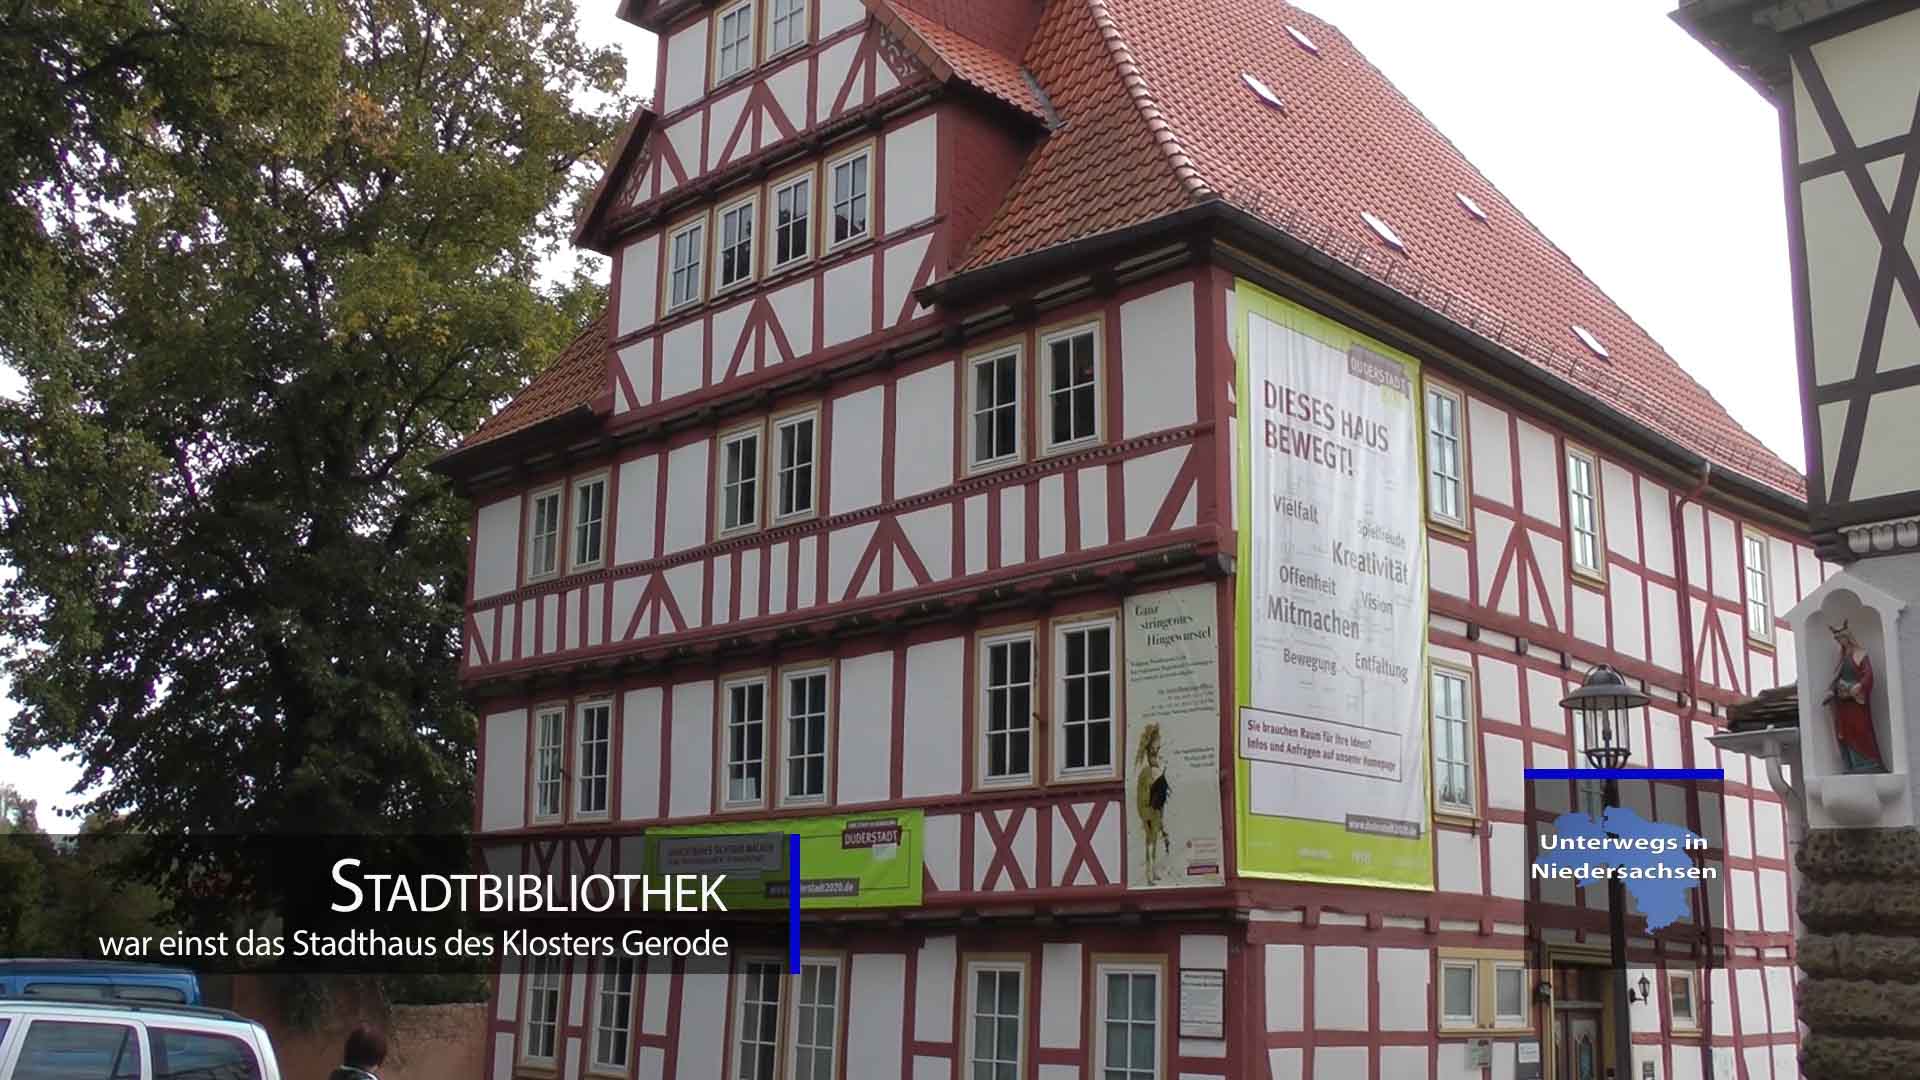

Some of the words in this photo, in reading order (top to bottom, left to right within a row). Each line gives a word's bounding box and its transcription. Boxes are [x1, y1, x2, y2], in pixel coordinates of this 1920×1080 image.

[1263, 379, 1335, 431] DIESES
[1341, 410, 1389, 452] HAUS
[1264, 419, 1353, 476] BEWEGT!
[1273, 494, 1319, 524] Vielfalt
[1332, 540, 1408, 585] Kreativität
[1279, 565, 1336, 596] Offenheit
[1267, 595, 1360, 640] Mitmachen
[1362, 591, 1393, 616] Vision
[1283, 648, 1337, 676] Bewegung
[1355, 652, 1409, 684] Entfaltung
[1247, 719, 1261, 732] Sie
[1262, 721, 1299, 737] brauchen
[1300, 727, 1321, 742] Raum
[1247, 737, 1268, 751] Infos
[1270, 740, 1285, 753] und
[1286, 743, 1321, 760] Anfragen
[1322, 748, 1334, 761] auf
[844, 829, 899, 846] DUDERSTADT
